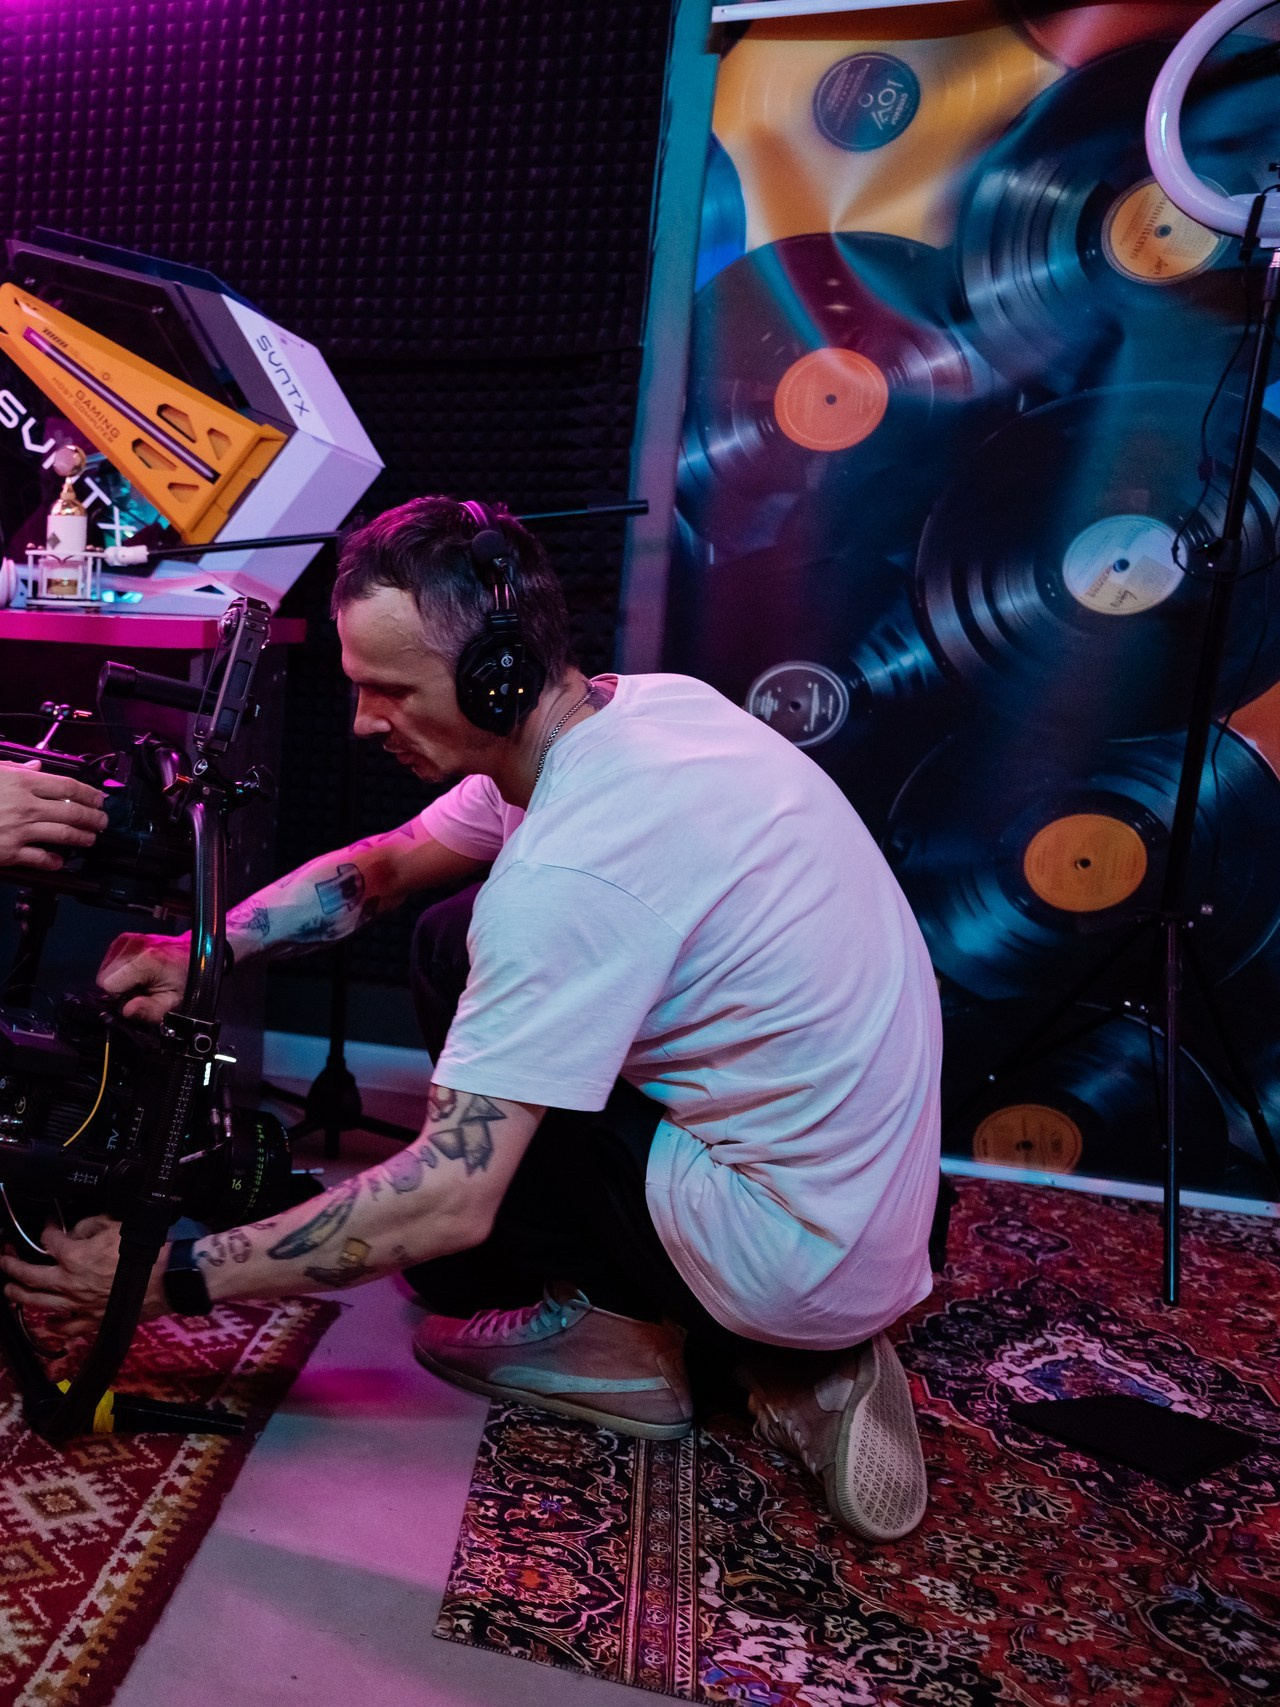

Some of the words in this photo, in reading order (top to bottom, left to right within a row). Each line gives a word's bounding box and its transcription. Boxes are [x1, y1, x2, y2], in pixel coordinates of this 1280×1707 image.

[73, 401, 114, 443] COMPUTER
[75, 390, 121, 439] GAMING
[231, 1179, 242, 1190] 16
